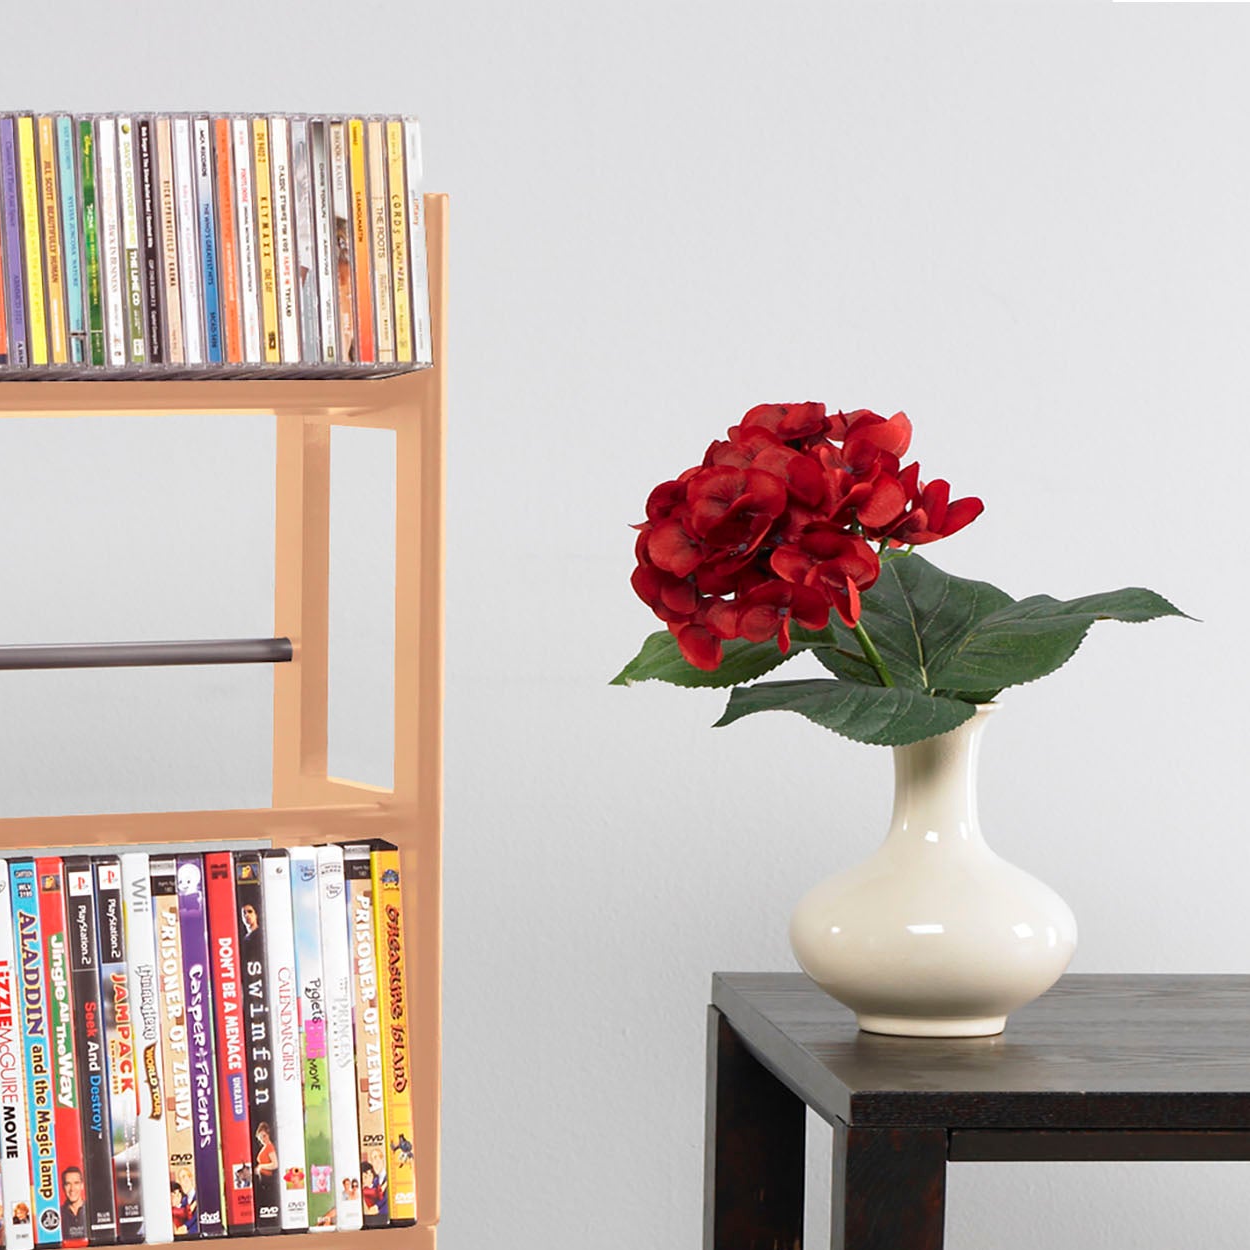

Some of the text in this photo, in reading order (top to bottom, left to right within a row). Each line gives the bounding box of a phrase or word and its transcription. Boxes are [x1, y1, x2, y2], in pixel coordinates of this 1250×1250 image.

[45, 177, 53, 200] SCOTT
[46, 206, 57, 253] BEAUTIFULLY
[376, 207, 386, 258] THE ROOTS
[51, 256, 59, 283] HUMAN
[205, 240, 213, 272] GREATEST
[132, 293, 140, 305] CD
[131, 878, 147, 912] Wii
[49, 935, 76, 1108] Jingle All The Way
[85, 1002, 97, 1037] Seek
[111, 974, 134, 1094] JAMPACK
[160, 911, 192, 1132] PRISONER OF ZENDA
[218, 937, 244, 1115] DON'T BE A MENACE UNRATED
[247, 961, 272, 1106] swimfan
[19, 911, 54, 1199] ALADDIN and the Magic lamp
[88, 1042, 101, 1071] And
[145, 1045, 162, 1116] WORLD TOUR
[4, 1106, 19, 1159] MOVIE
